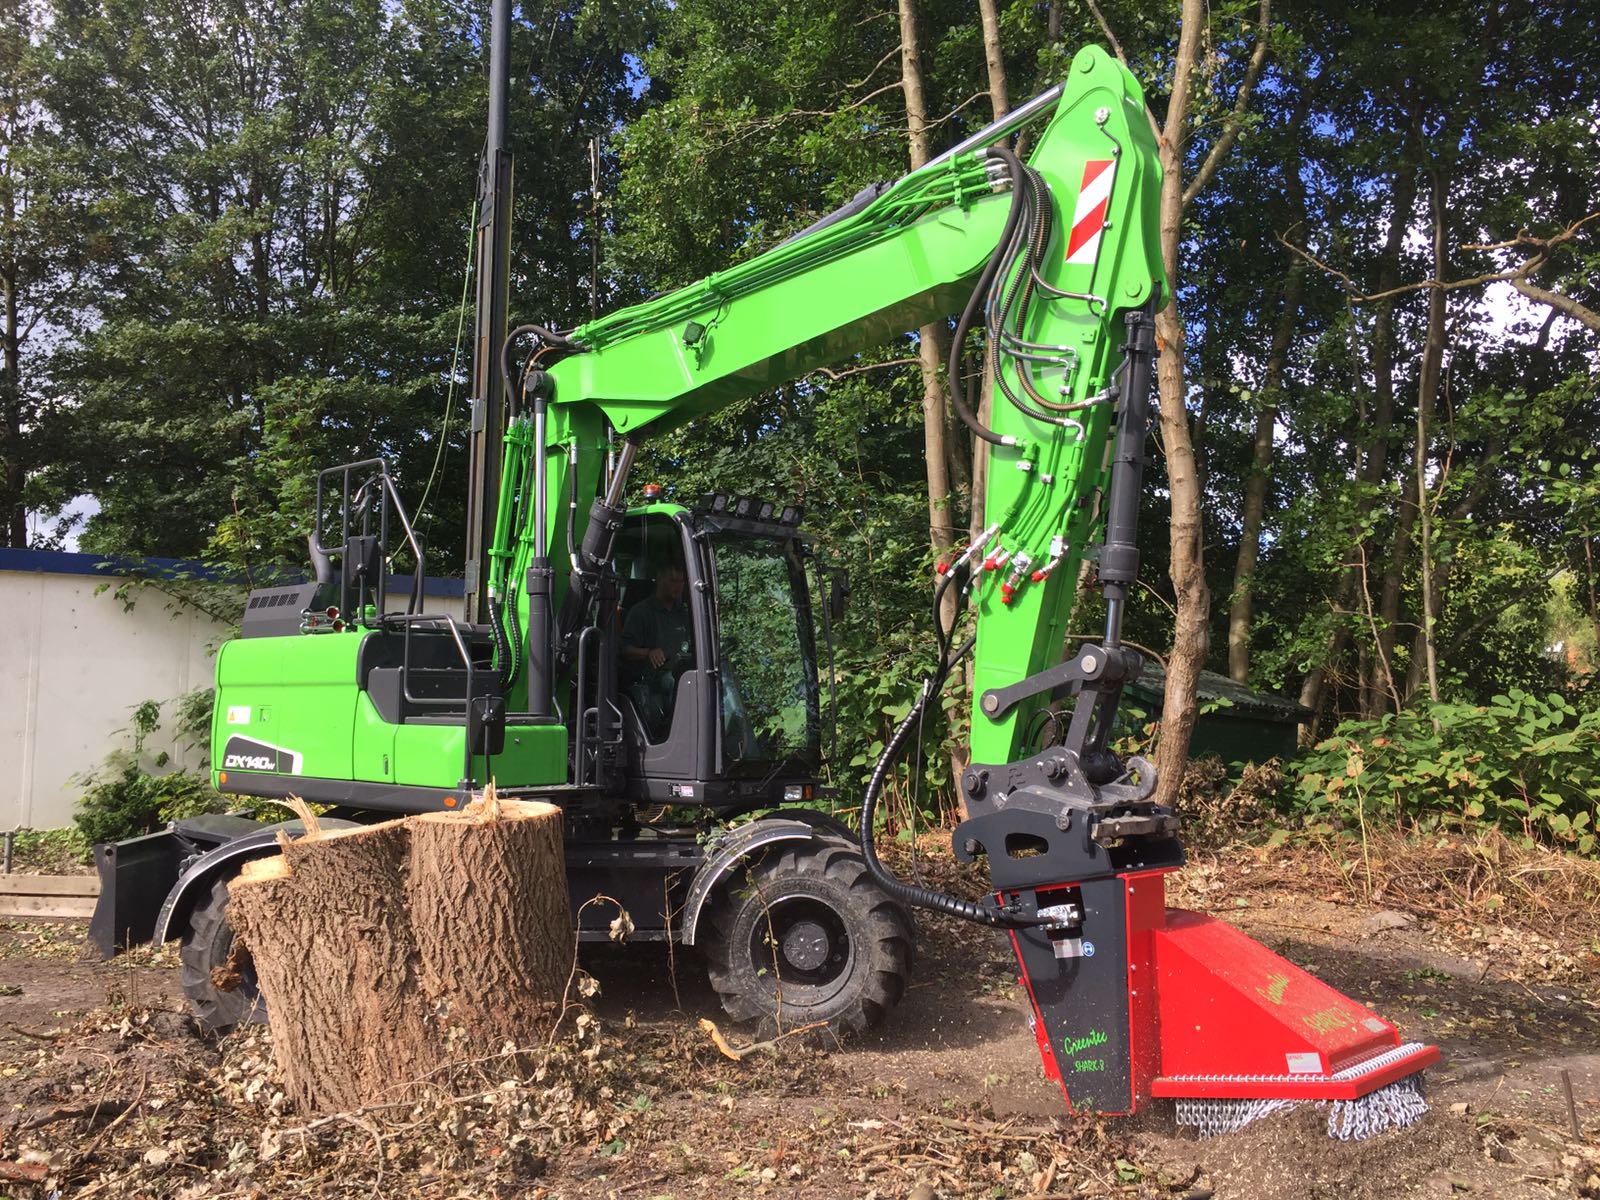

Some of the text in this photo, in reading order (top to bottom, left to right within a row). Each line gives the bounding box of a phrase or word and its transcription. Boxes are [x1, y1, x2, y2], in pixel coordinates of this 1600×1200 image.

[1064, 1029, 1108, 1057] Greentec
[1075, 1059, 1105, 1072] SHARK 8
